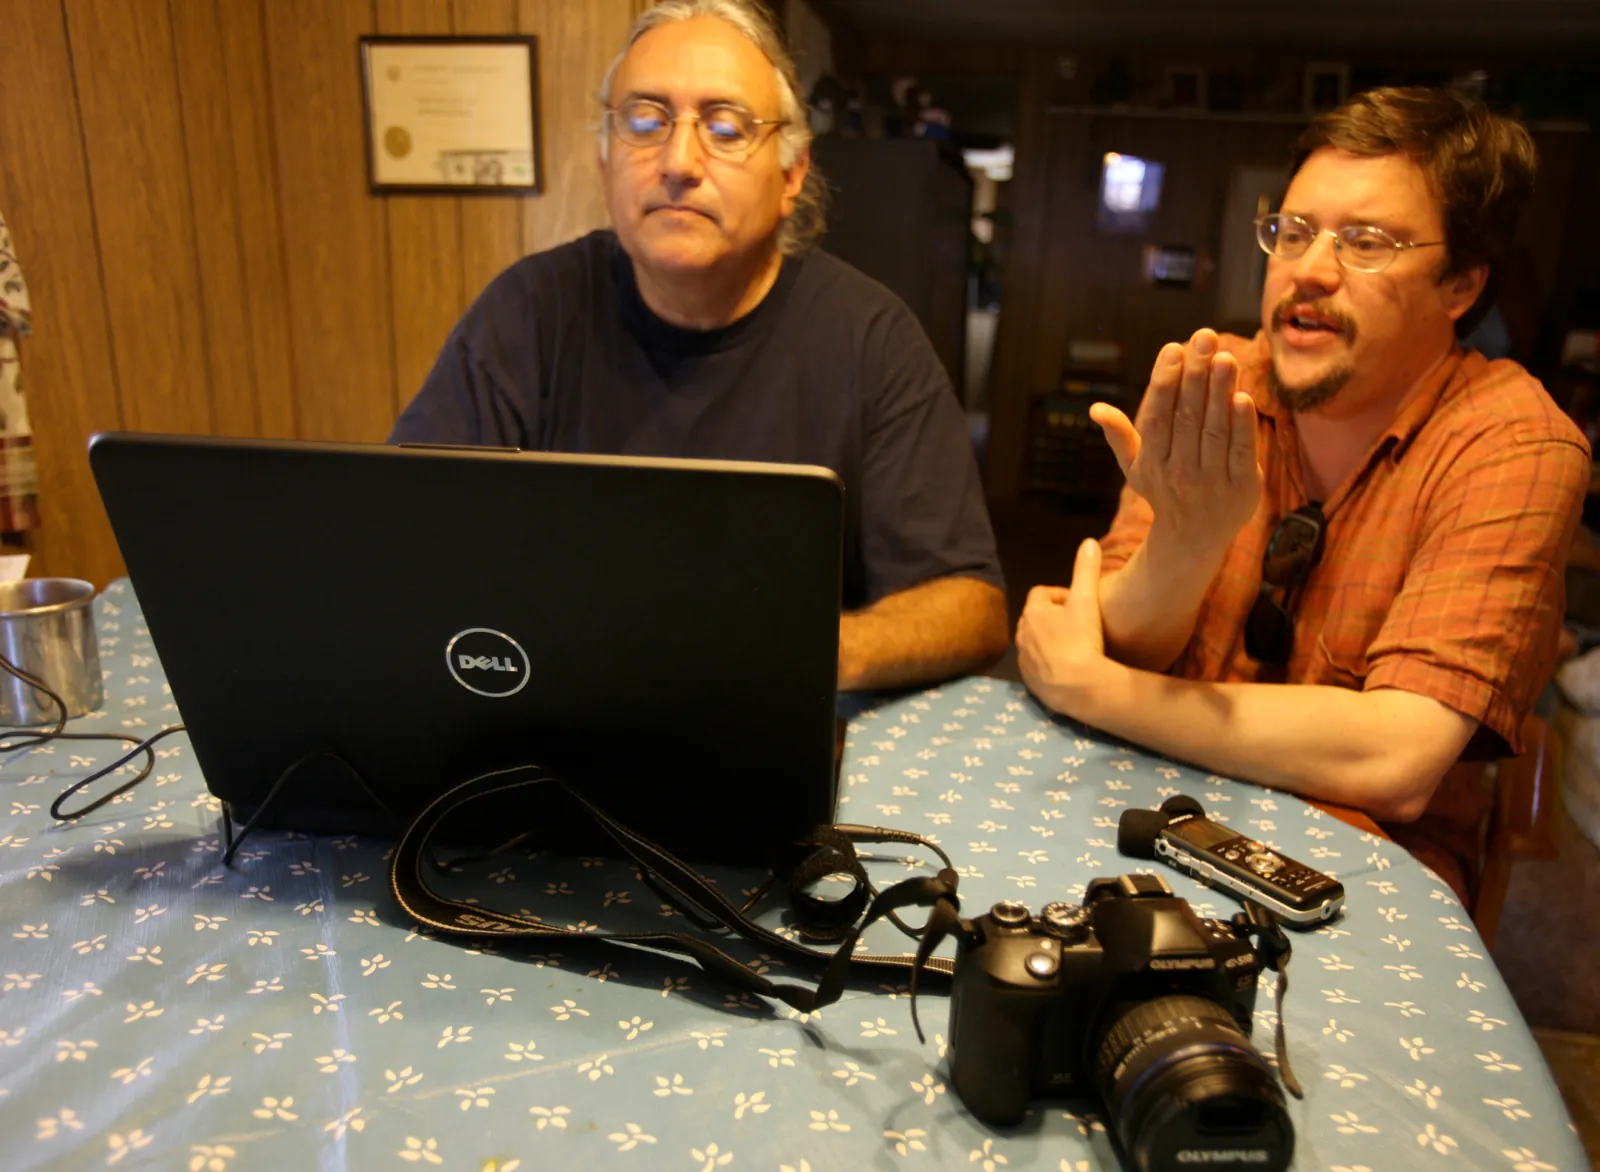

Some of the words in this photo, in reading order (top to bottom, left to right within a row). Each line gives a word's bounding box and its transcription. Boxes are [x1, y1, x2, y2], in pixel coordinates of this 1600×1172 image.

[458, 654, 518, 672] DELL
[1150, 957, 1215, 971] OLYMPUS
[1177, 1149, 1269, 1165] OLYMPUS
